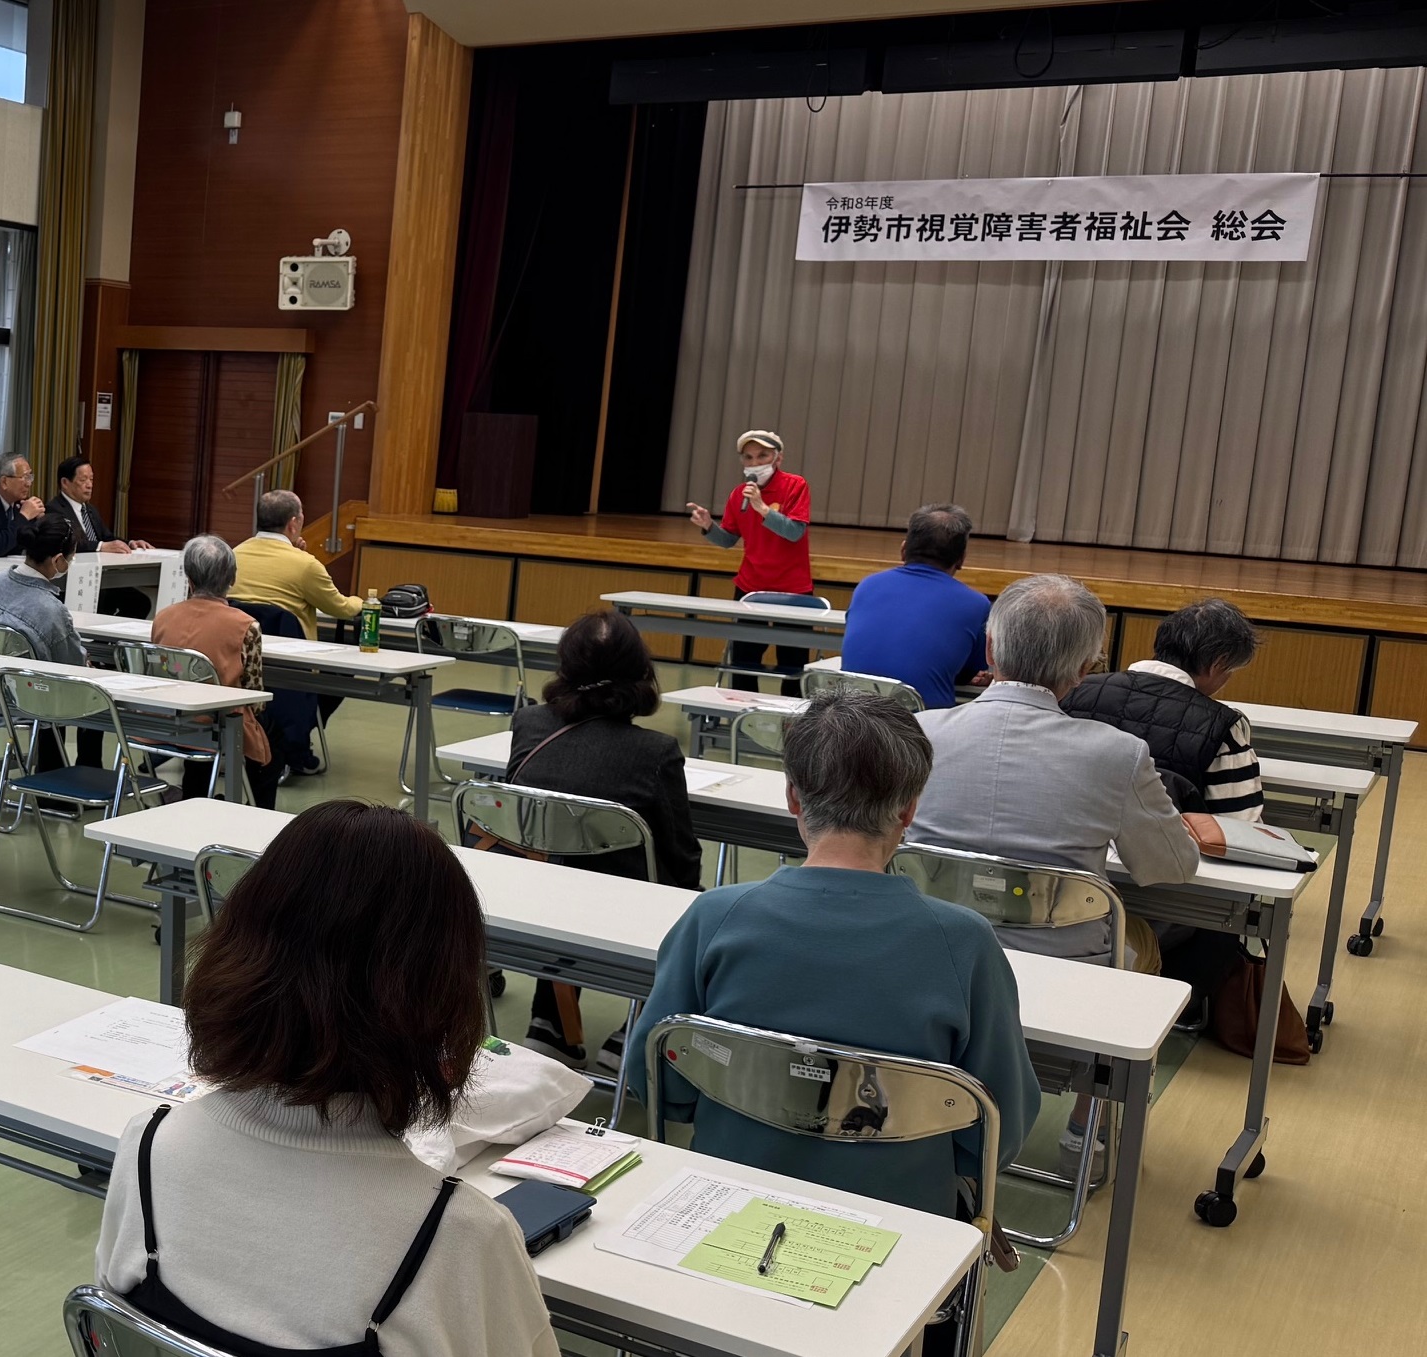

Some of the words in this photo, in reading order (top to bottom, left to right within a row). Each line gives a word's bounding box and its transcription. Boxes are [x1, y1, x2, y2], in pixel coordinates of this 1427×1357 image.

[825, 195, 894, 211] 令和8年度
[821, 209, 1192, 243] 伊勢市視覚障害者福祉会
[1210, 209, 1288, 242] 総会
[309, 279, 341, 289] RAMSA
